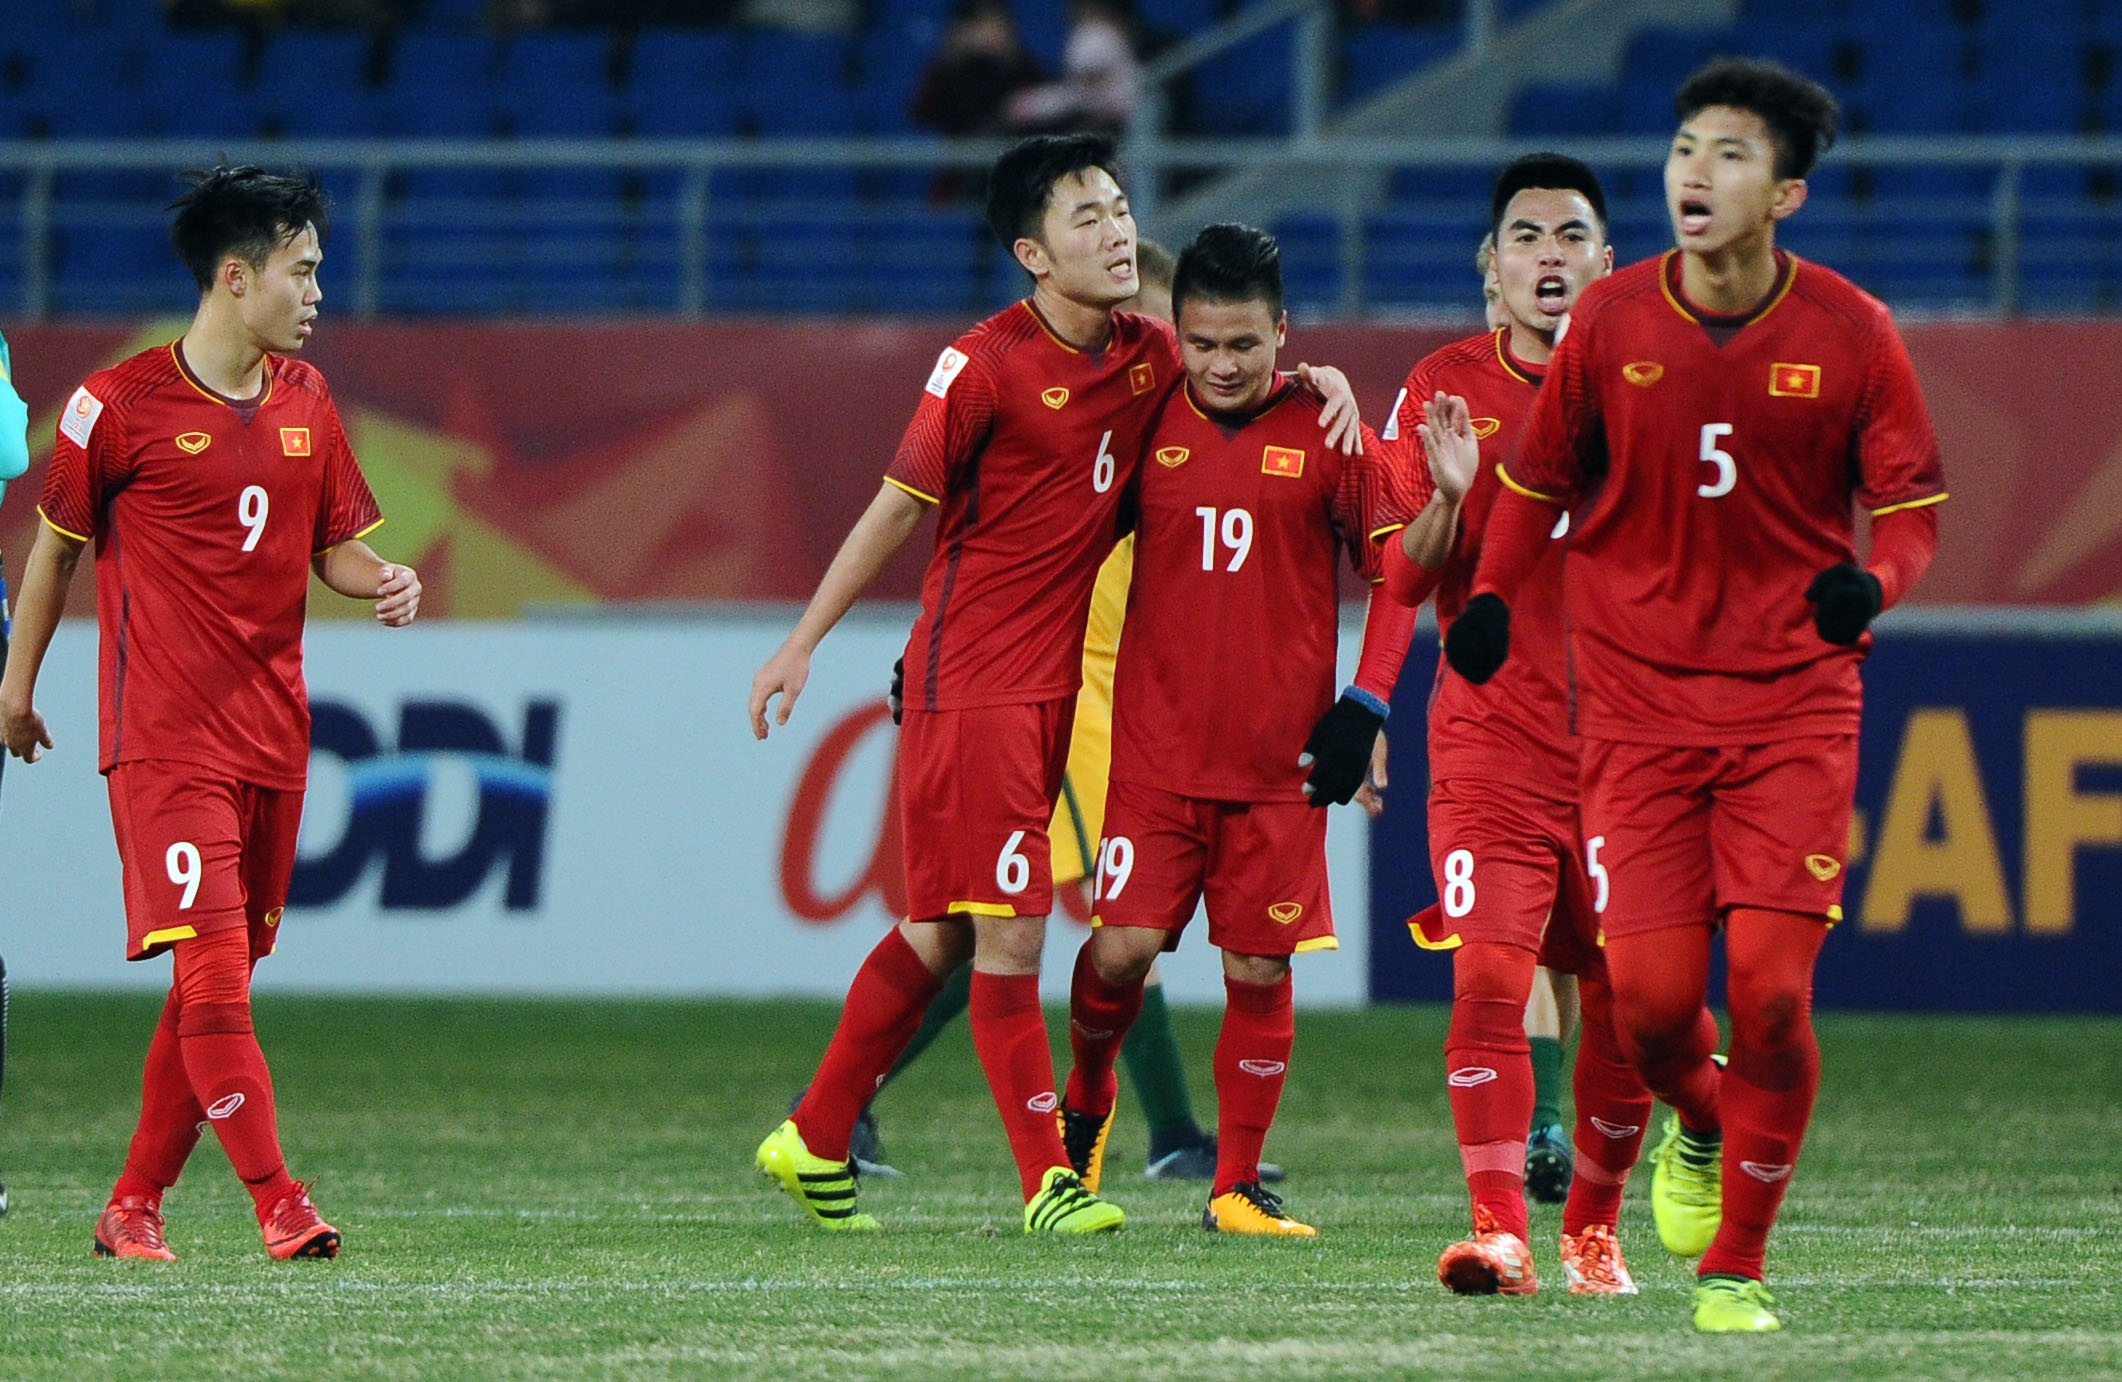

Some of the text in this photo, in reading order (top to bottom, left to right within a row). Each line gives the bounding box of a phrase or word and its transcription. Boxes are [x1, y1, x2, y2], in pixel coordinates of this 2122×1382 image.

[1093, 430, 1115, 493] 6
[1698, 422, 1737, 498] 5
[238, 485, 269, 552] 9
[1195, 506, 1254, 573] 19
[1852, 709, 2122, 932] AF
[165, 841, 202, 910] 9
[995, 830, 1030, 895] 6
[1094, 836, 1135, 901] 19
[1443, 849, 1476, 918] 8
[1587, 835, 1610, 914] 5
